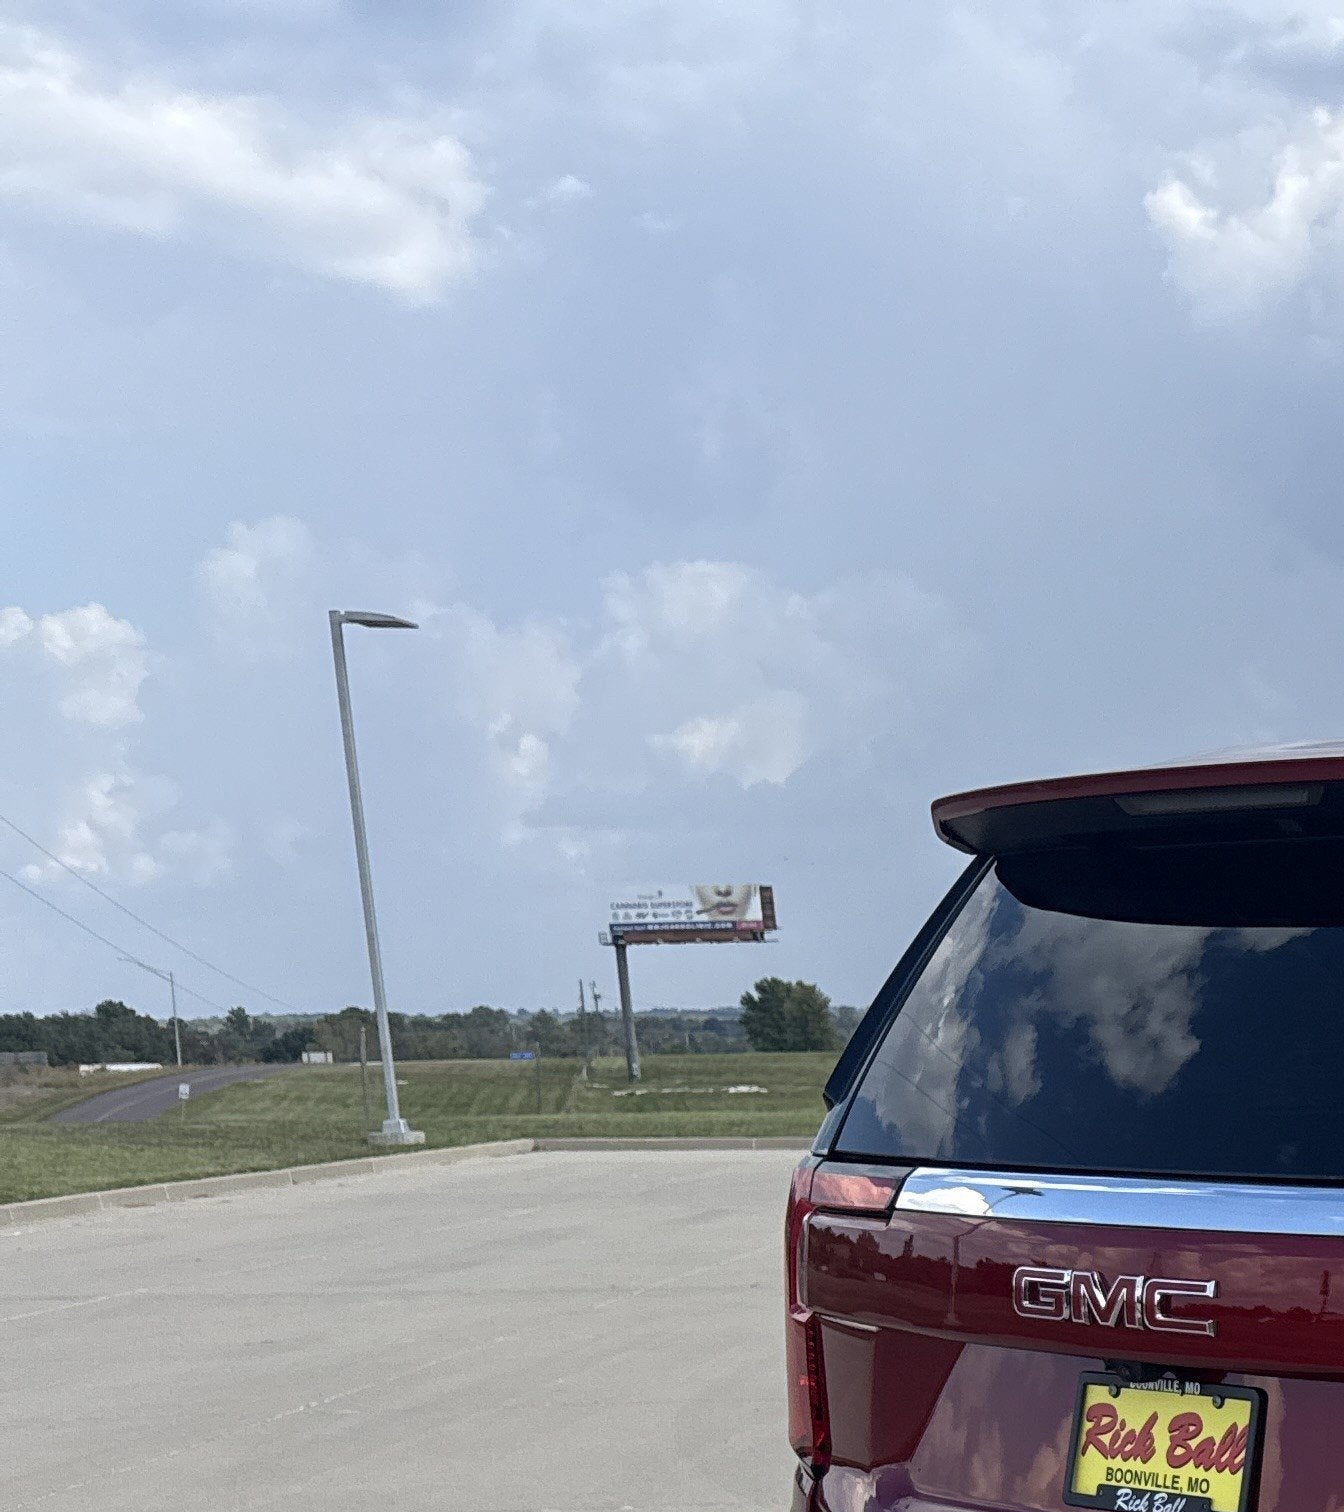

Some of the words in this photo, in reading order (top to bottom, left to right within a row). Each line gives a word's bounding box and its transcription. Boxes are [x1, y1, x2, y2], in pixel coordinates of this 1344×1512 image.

[1013, 1266, 1217, 1337] GMC
[1184, 1381, 1201, 1395] MO
[1082, 1403, 1159, 1465] Rick
[1166, 1411, 1250, 1476] Ball
[1105, 1466, 1184, 1494] BOONVILLE,
[1187, 1476, 1211, 1495] MO
